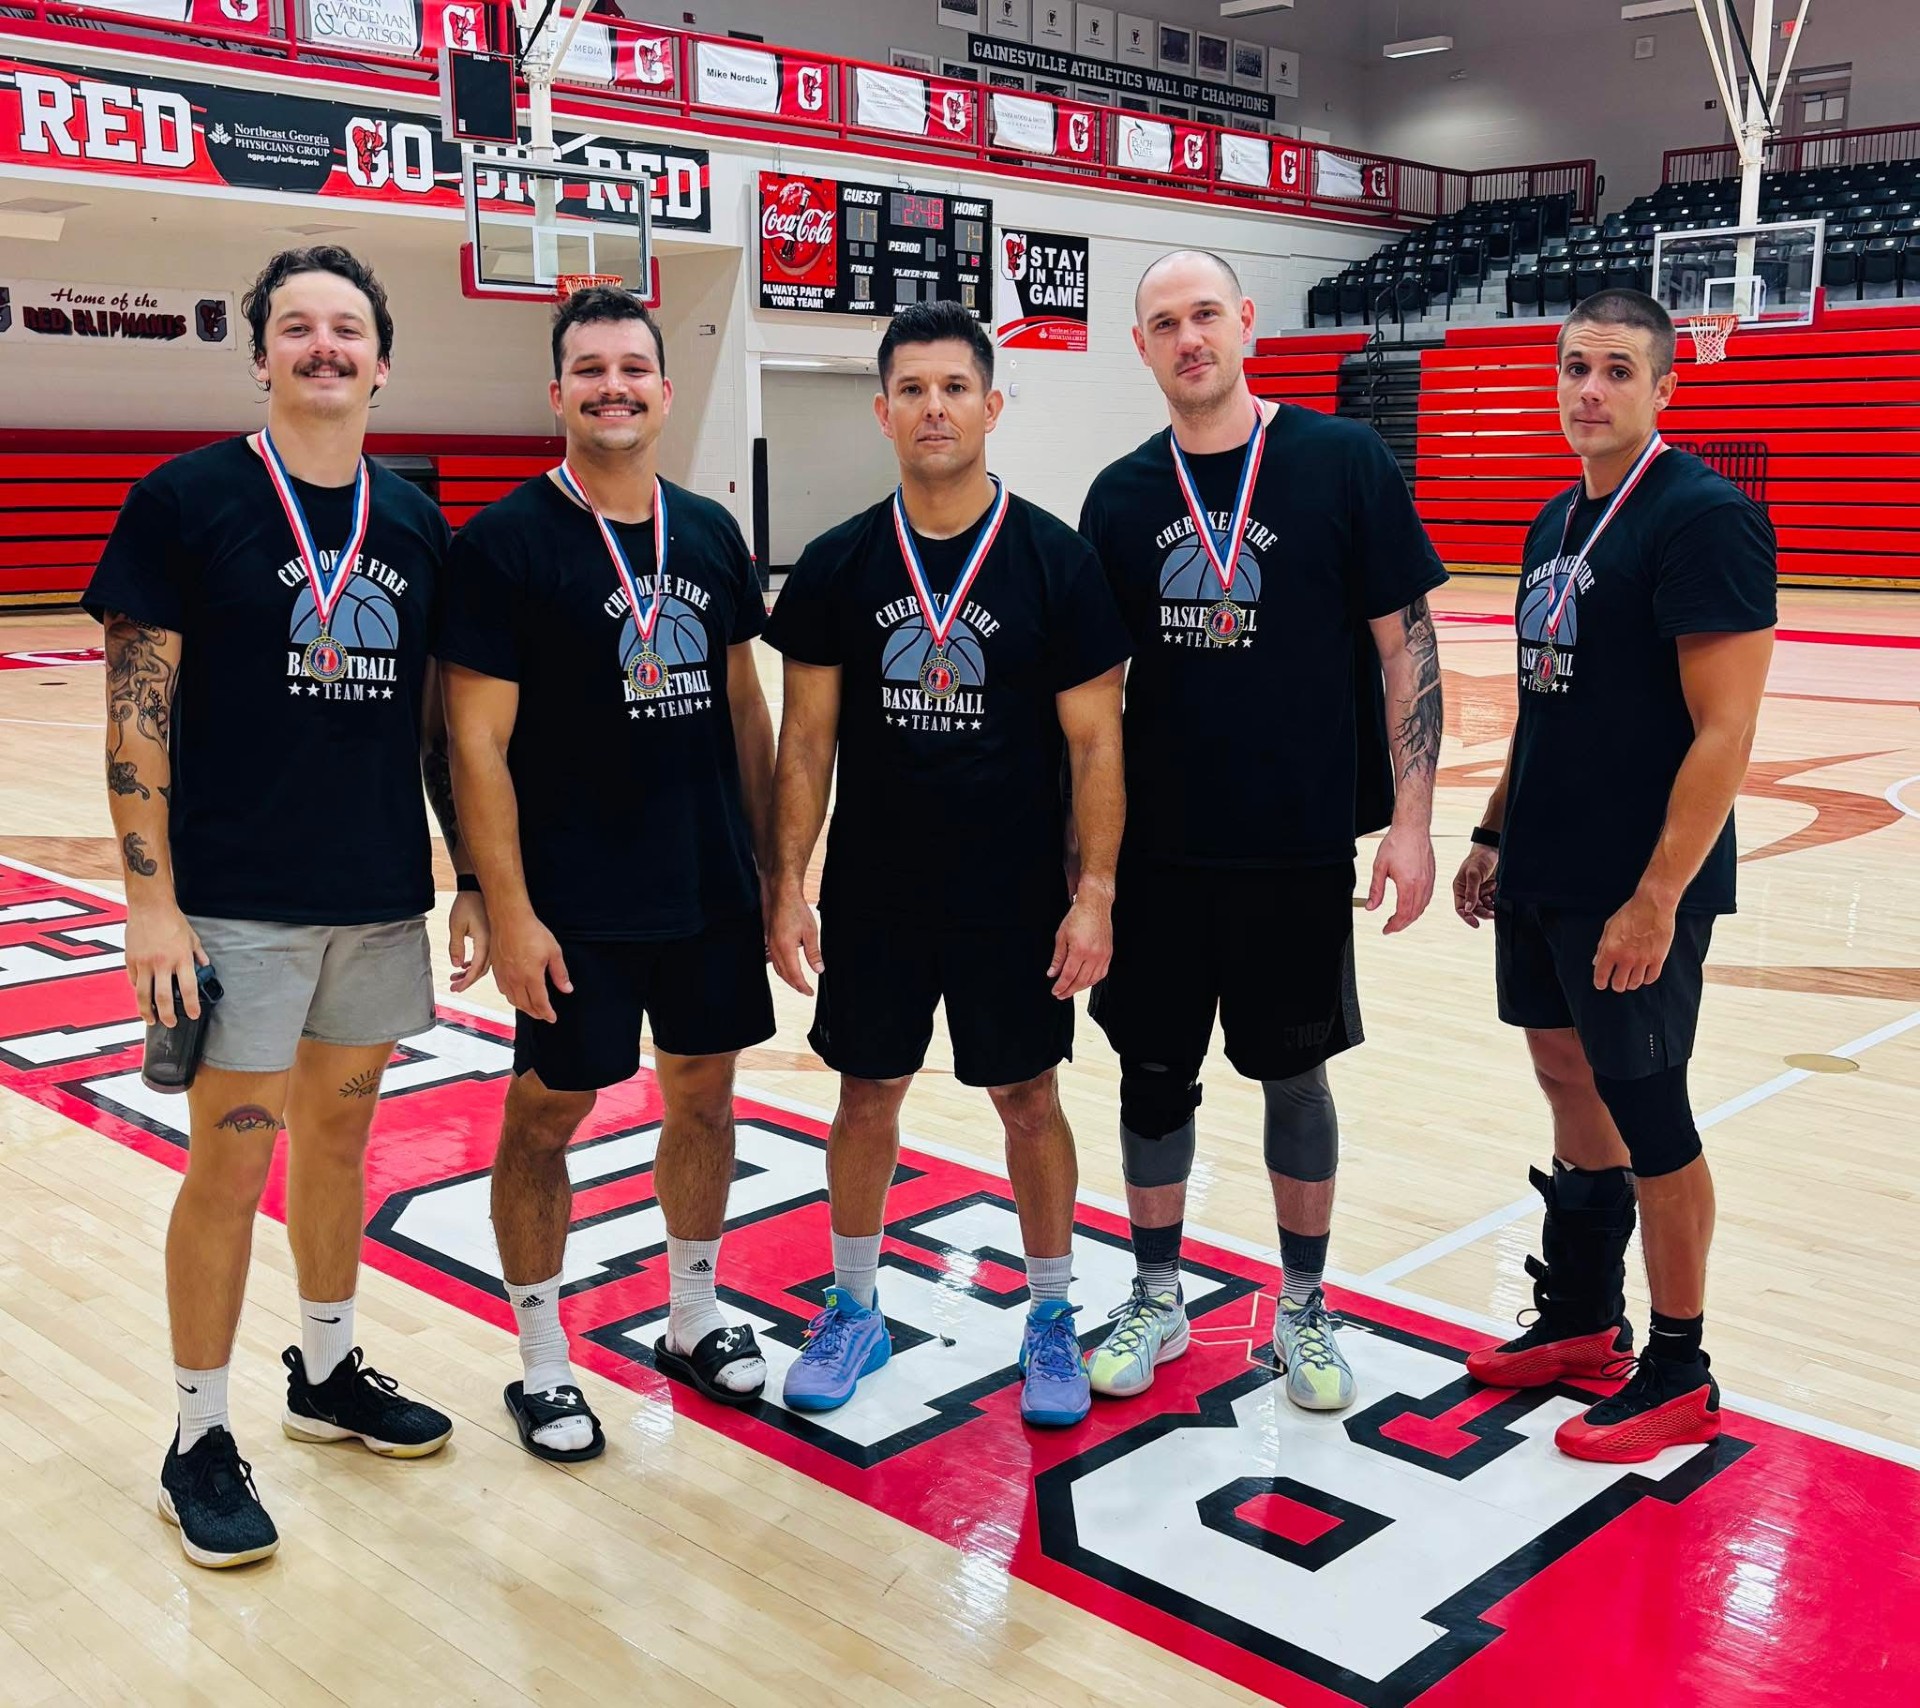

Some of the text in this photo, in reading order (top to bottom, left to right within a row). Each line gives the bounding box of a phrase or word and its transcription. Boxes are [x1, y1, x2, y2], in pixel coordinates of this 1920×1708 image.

[314, 3, 412, 46] & CARLSON
[330, 1, 410, 30] VARDEMAN
[574, 43, 603, 57] MEDIA
[706, 67, 768, 87] Mike Nordholz
[973, 41, 1269, 113] GAINESVILLE ATHLETICS WALL OF CHAMPIONS
[15, 70, 195, 169] RED
[234, 123, 329, 146] Northeast Georgia
[235, 138, 330, 158] PHYSICIANS GROUP
[345, 116, 435, 194] GO
[585, 145, 702, 220] RED
[844, 188, 881, 204] GUEST
[903, 195, 944, 229] 2:48
[953, 201, 984, 217] HOME
[889, 241, 921, 253] PERIOD
[1030, 246, 1085, 271] STAY
[850, 264, 873, 274] FOULS
[958, 273, 979, 283] FOULS
[1030, 269, 1085, 287] IN THE
[50, 288, 158, 311] Home of the
[763, 284, 835, 299] ALWAYS PART OF
[771, 296, 824, 309] YOUR TEAM!
[1029, 285, 1085, 308] GAME
[850, 301, 875, 310] POINTS
[23, 306, 72, 335] RED
[72, 309, 187, 340] ELEPHANTS
[366, 558, 408, 597] FIRE
[675, 577, 711, 611] FIRE
[961, 600, 1000, 638] FIRE
[1160, 606, 1257, 632] BASKELL
[322, 682, 364, 700] TEAM
[881, 686, 984, 714] BASKETBALL
[658, 698, 693, 718] TEAM
[911, 714, 951, 732] TEAM
